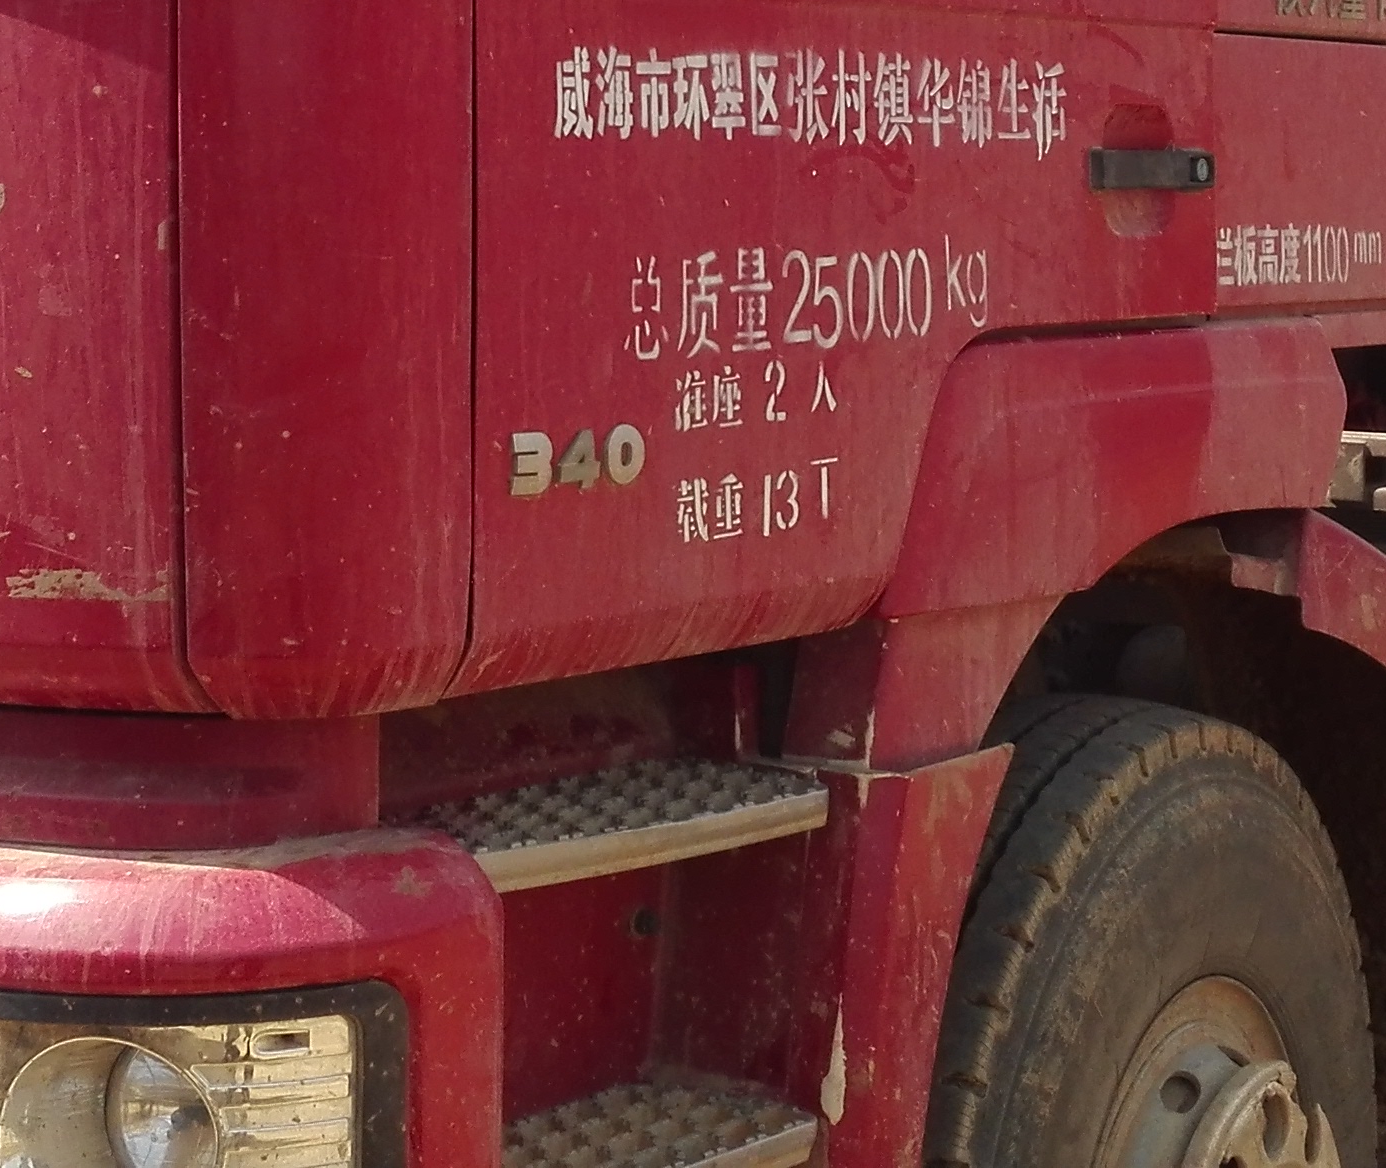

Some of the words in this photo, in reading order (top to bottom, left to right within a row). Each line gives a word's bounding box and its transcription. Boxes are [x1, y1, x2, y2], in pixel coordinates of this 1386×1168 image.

[554, 45, 1067, 161] 威海市环翠区张村镇华锦生活
[510, 423, 645, 496] 340
